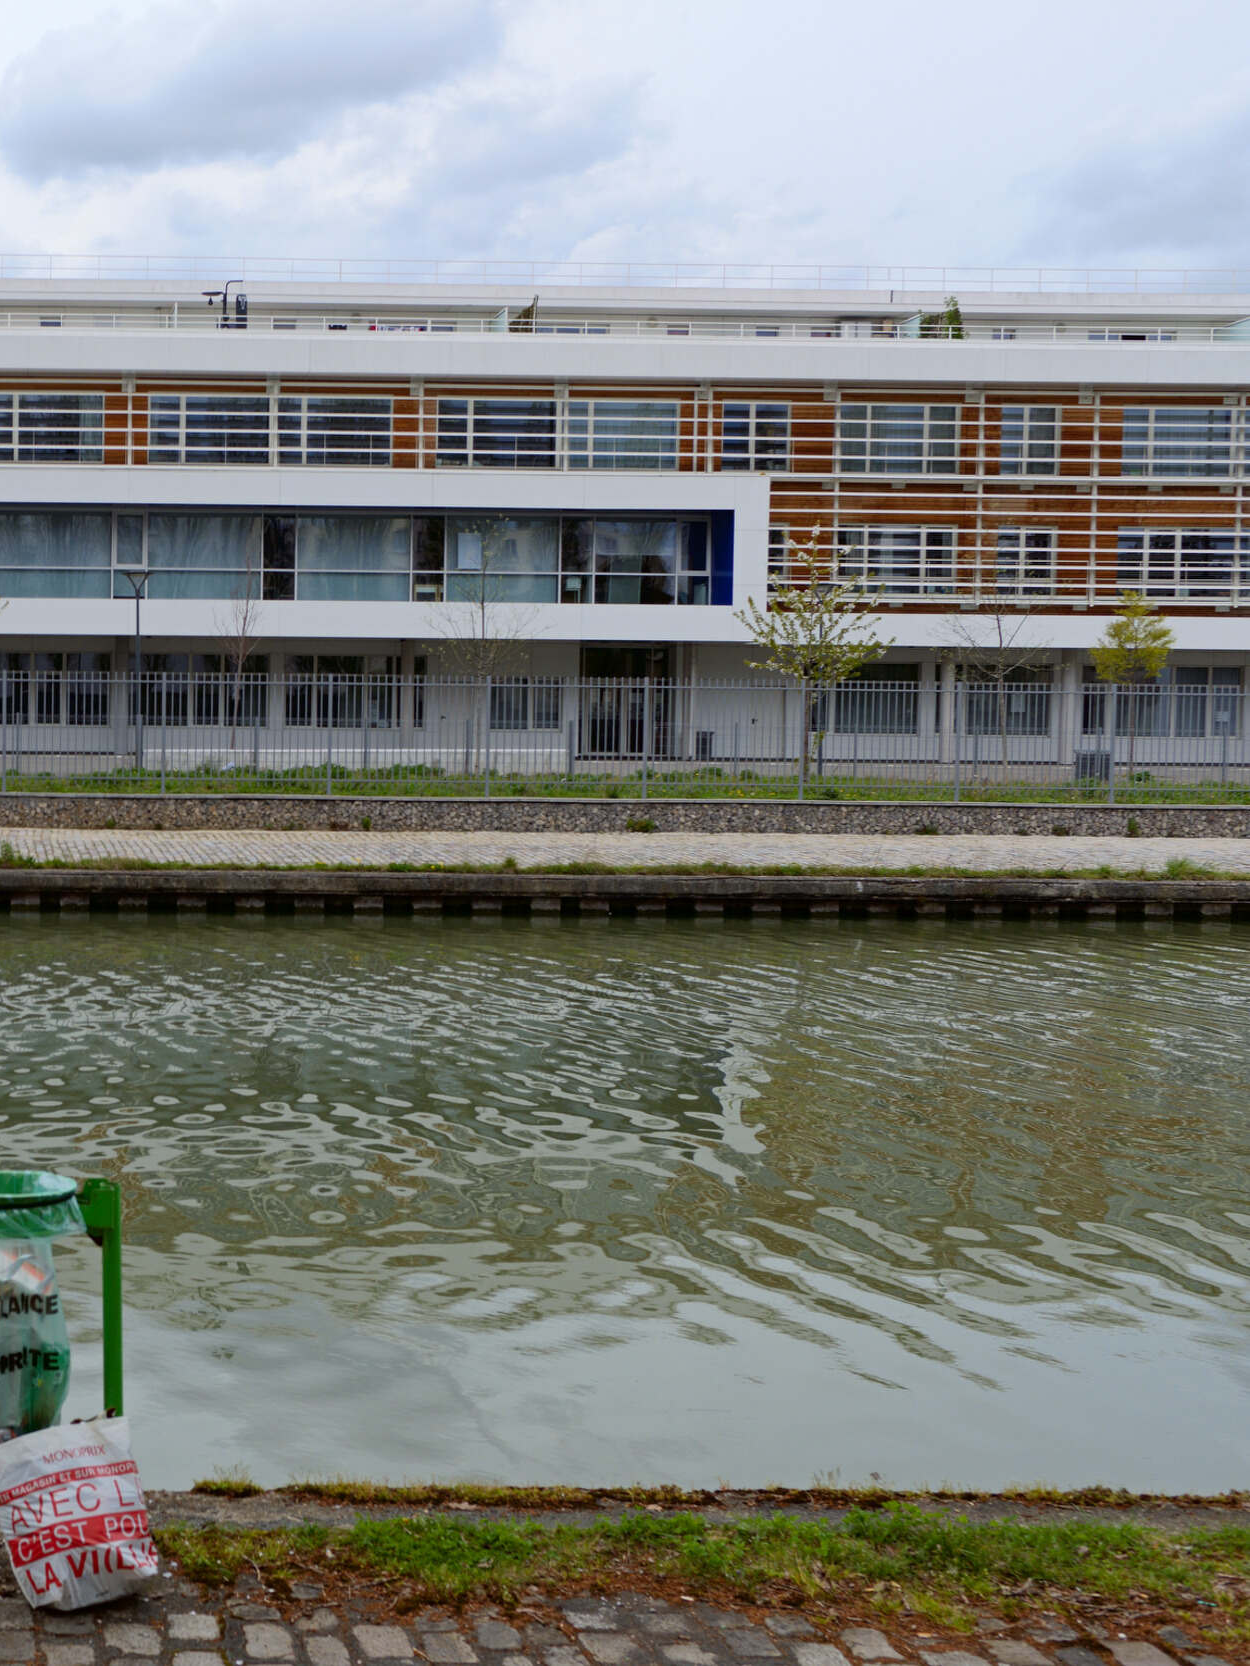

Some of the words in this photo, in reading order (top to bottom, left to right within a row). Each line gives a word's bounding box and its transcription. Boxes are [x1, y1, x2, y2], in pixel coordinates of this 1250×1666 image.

[42, 1444, 107, 1465] MONOPRIX
[75, 1468, 95, 1479] SUR
[11, 1482, 101, 1534] AVEC
[17, 1521, 88, 1562] C'EST
[25, 1562, 63, 1595] LA
